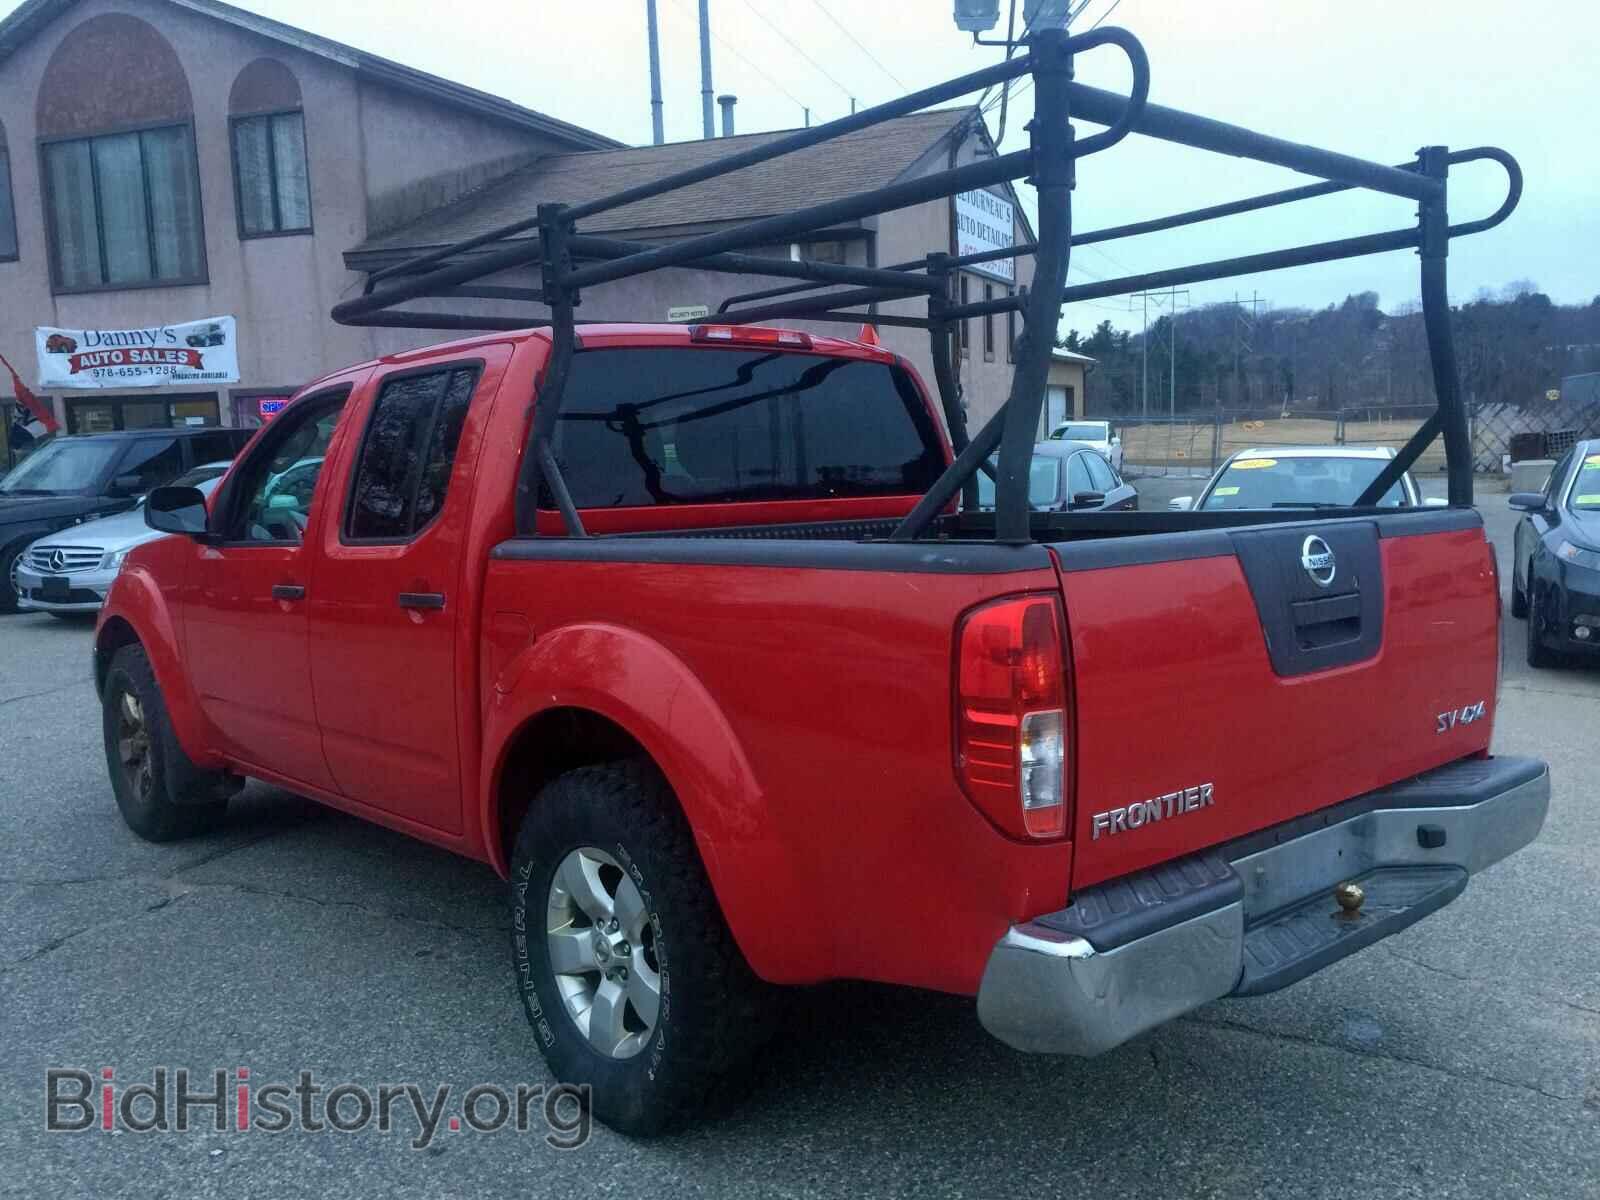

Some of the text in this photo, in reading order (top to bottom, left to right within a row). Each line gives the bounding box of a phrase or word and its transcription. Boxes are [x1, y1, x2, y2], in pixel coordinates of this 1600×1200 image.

[83, 326, 177, 348] Danny's
[80, 349, 188, 367] AUTO SALES
[92, 365, 177, 378] 978-655-1288
[1437, 711, 1458, 734] SV
[1092, 782, 1215, 840] FRONTIER
[514, 860, 556, 1049] GENERAL
